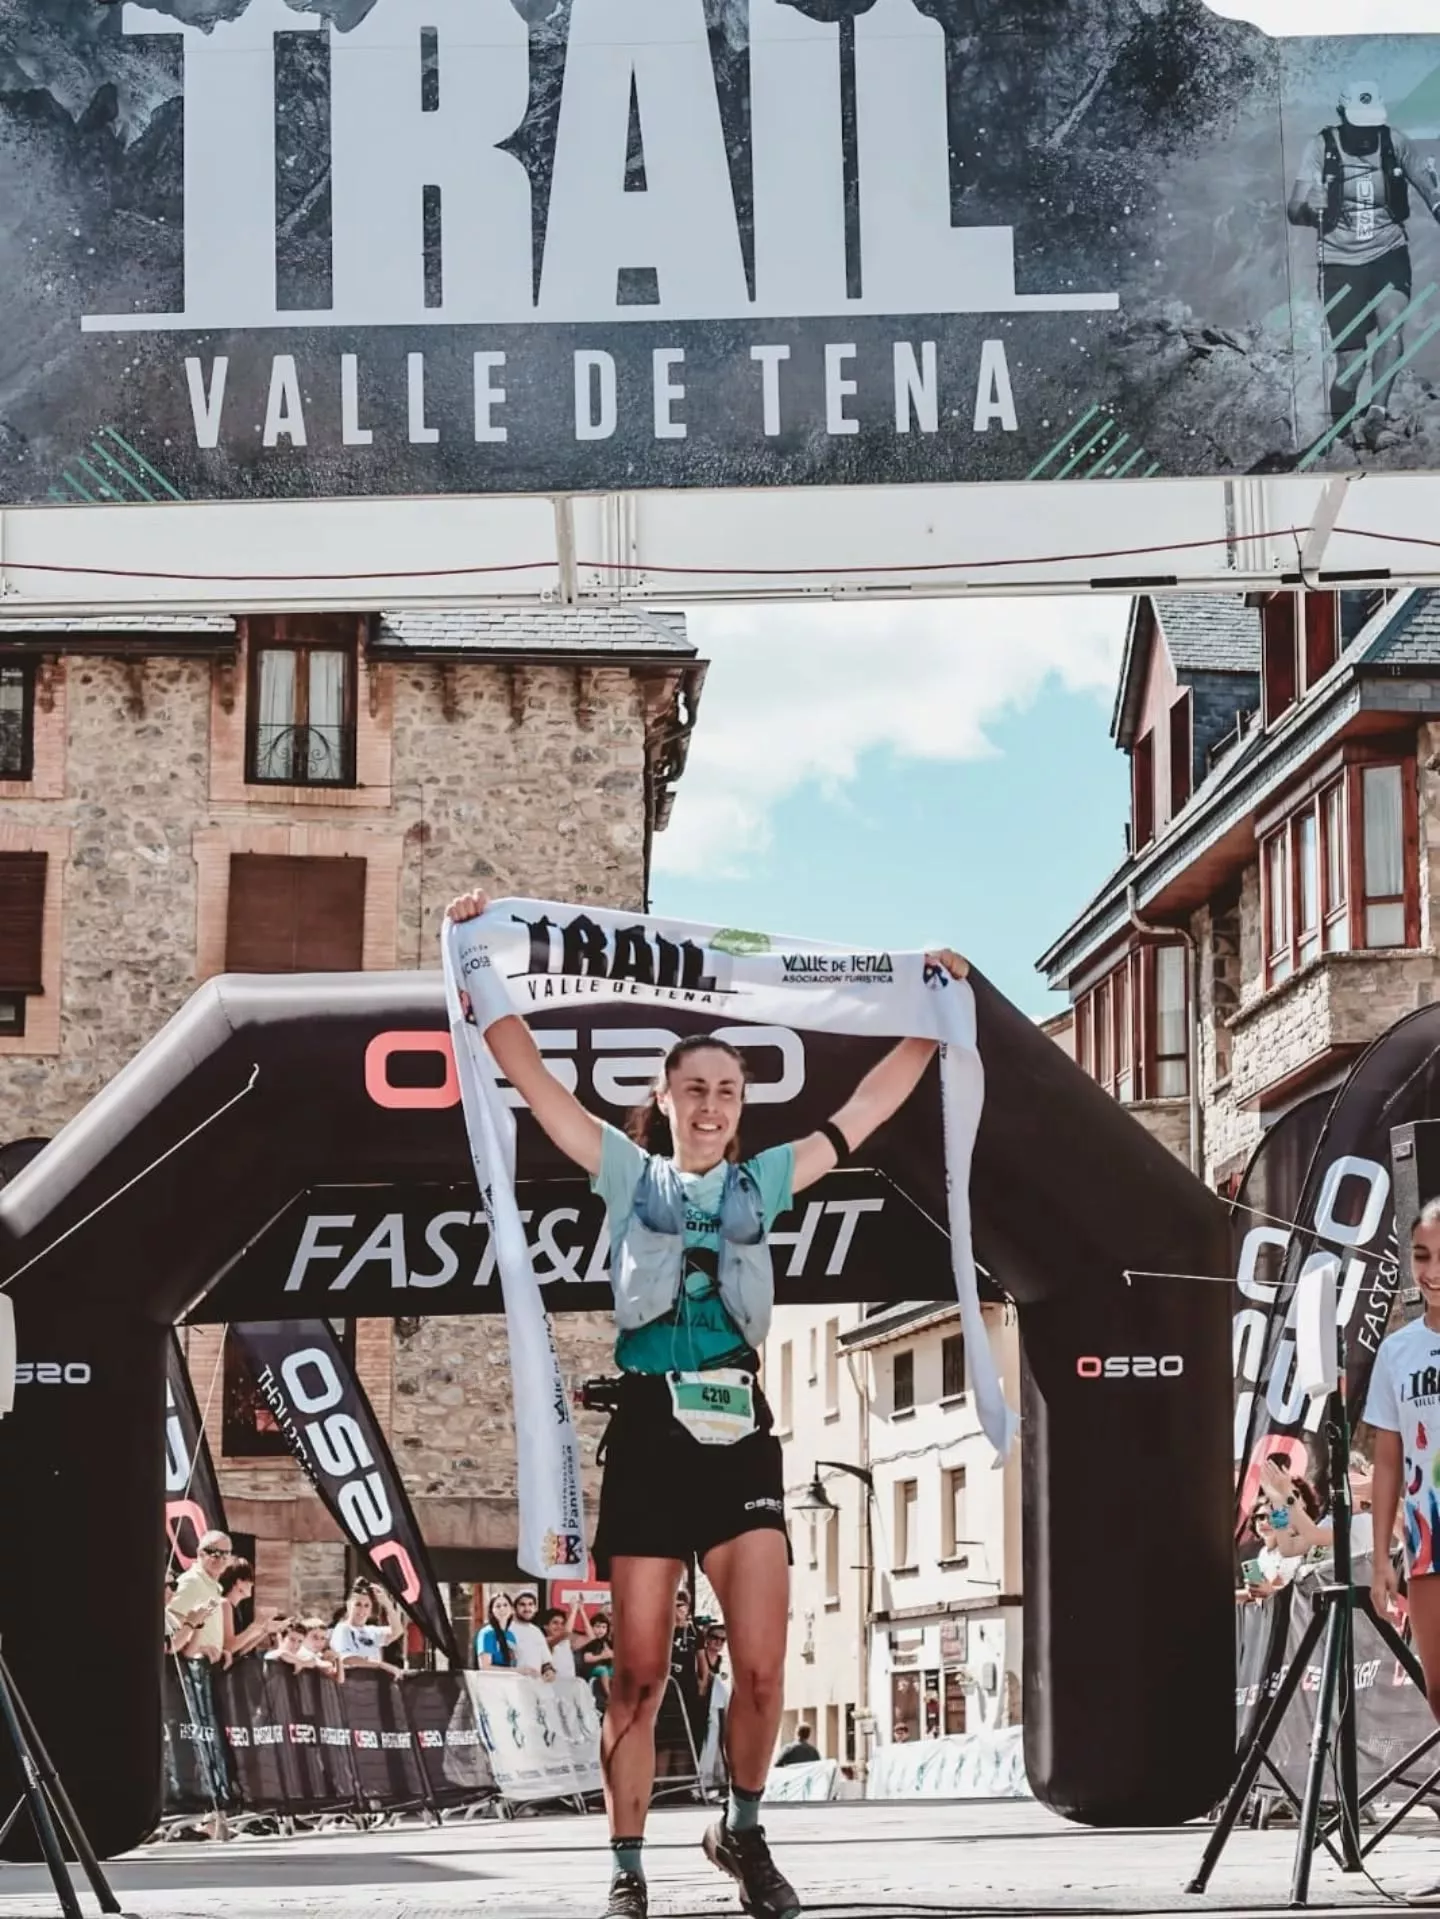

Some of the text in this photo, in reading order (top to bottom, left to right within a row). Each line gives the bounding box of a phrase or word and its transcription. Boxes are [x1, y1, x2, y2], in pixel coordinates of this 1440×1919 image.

[95, 0, 1070, 331] TRAIL
[185, 340, 1018, 449] VALLE DE TENA
[508, 914, 726, 991] TRAIL
[528, 978, 599, 1000] VALLE
[653, 987, 712, 1004] TENA
[283, 1198, 884, 1291] FAST&LHT
[702, 1387, 731, 1405] 4210
